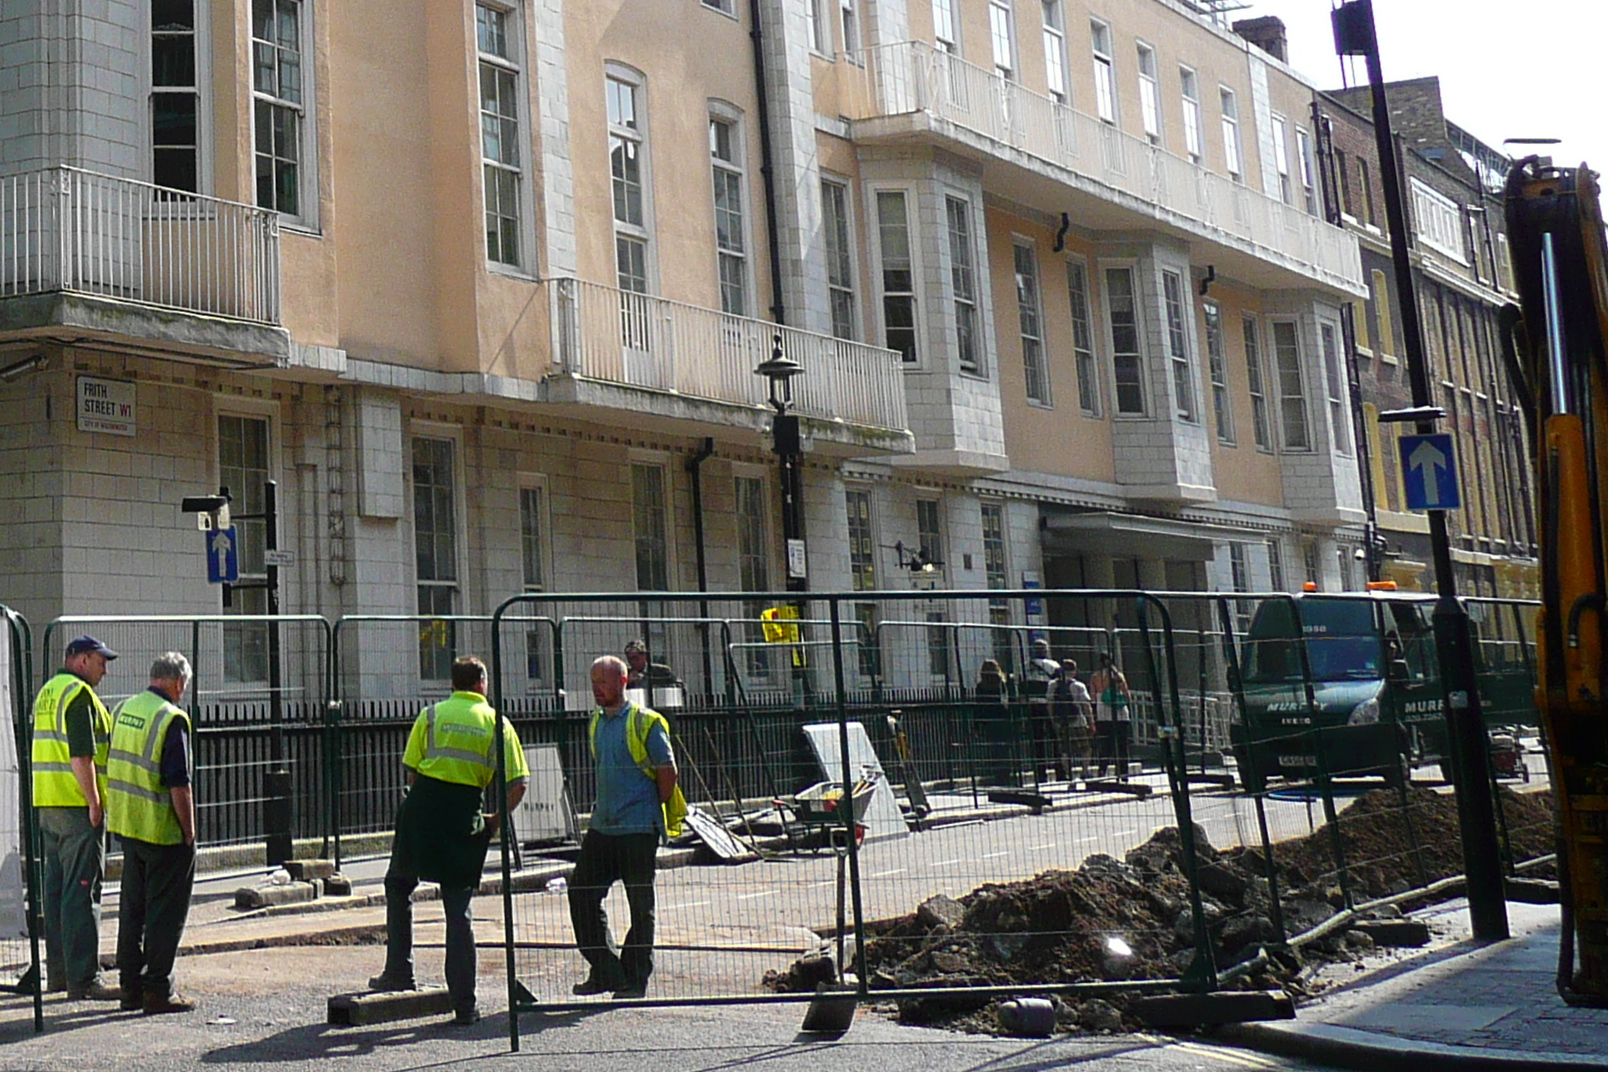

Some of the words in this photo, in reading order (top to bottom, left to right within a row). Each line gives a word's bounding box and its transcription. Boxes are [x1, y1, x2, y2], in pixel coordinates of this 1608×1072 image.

[84, 382, 108, 398] FRITH
[84, 399, 115, 416] STREET
[120, 404, 131, 418] W1
[1267, 701, 1327, 712] MURPY
